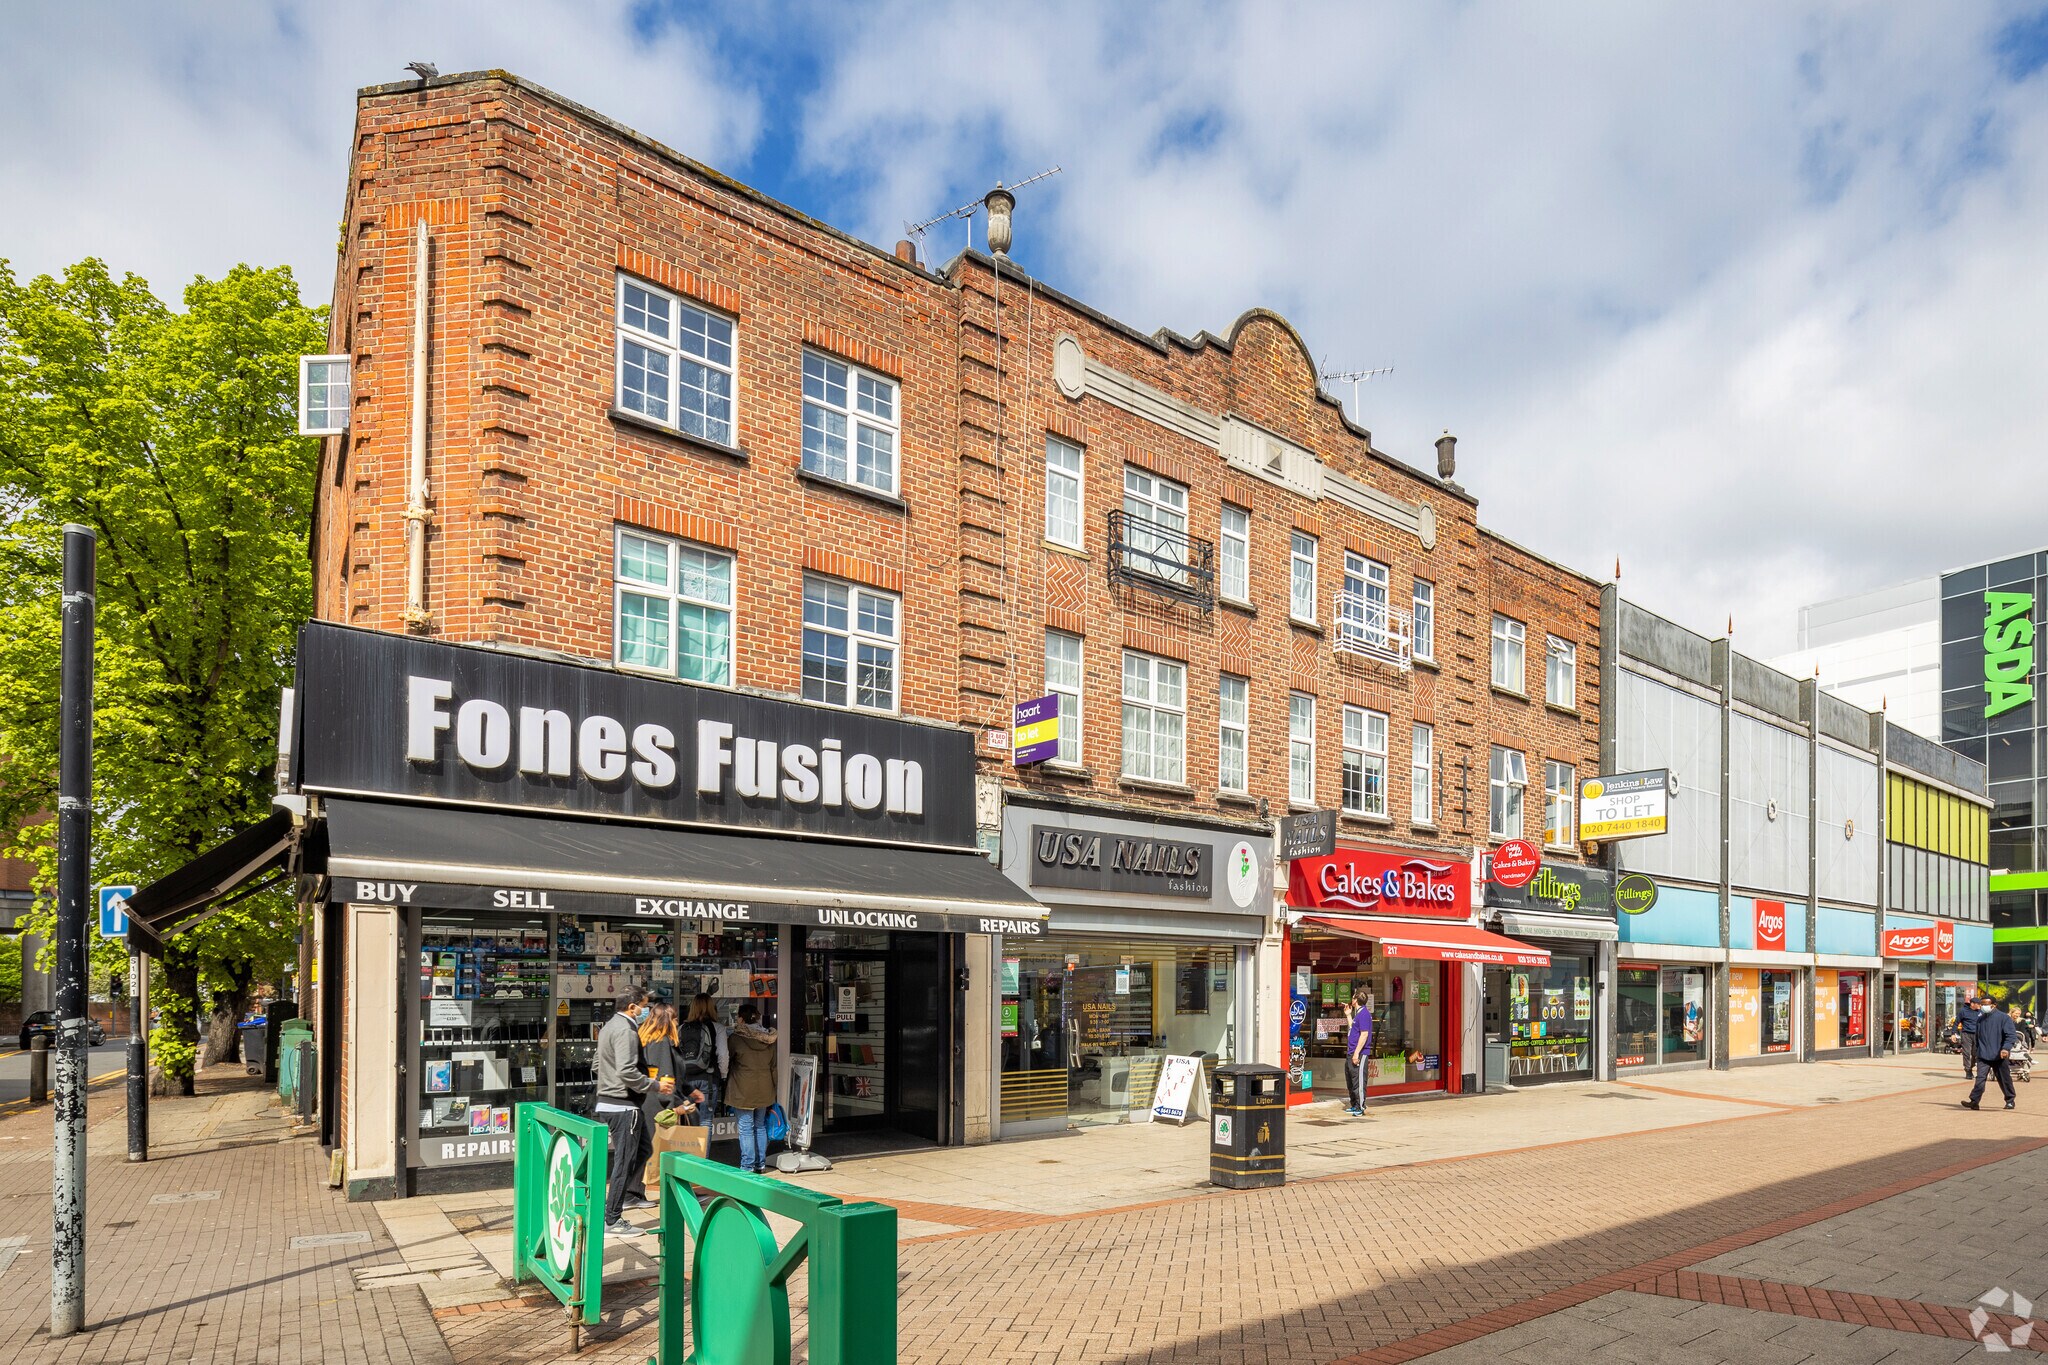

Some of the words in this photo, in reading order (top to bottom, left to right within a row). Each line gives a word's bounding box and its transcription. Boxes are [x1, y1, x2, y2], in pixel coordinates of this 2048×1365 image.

[1983, 591, 2034, 719] ASDA
[1016, 703, 1041, 720] haart
[1017, 730, 1027, 742] to
[1027, 727, 1040, 739] let
[407, 675, 677, 788] Fones
[697, 718, 923, 816] Fusion
[1606, 780, 1640, 793] Jenkins
[1644, 777, 1663, 786] Law
[1609, 794, 1641, 806] SHOP
[1596, 807, 1618, 820] TO
[1624, 803, 1655, 818] LET
[1294, 814, 1318, 827] USA
[1585, 824, 1603, 834] 020
[1606, 821, 1632, 832] 7440
[1637, 818, 1661, 829] 1840
[1284, 825, 1327, 847] NAILS
[1038, 830, 1101, 869] USA
[1110, 838, 1202, 878] NAILS
[1289, 845, 1321, 857] fashion
[1493, 860, 1511, 869] Cakes
[1517, 858, 1536, 867] Bakes
[1168, 879, 1209, 893] fashion
[1320, 862, 1381, 896] Cakes
[1403, 870, 1455, 902] Bakes
[356, 881, 418, 903] BUY
[493, 889, 555, 910] SELL
[1618, 887, 1652, 901] Fillings
[635, 898, 750, 920] EXCHANGE
[818, 909, 918, 929] UNLOCKING
[980, 918, 1041, 935] REPAIRS
[1758, 910, 1784, 934] Argos
[1889, 934, 1930, 948] Argos
[1938, 929, 1953, 948] Argos
[1387, 946, 1398, 955] 217
[1097, 1002, 1116, 1010] NAILS
[1255, 1097, 1274, 1105] Litter
